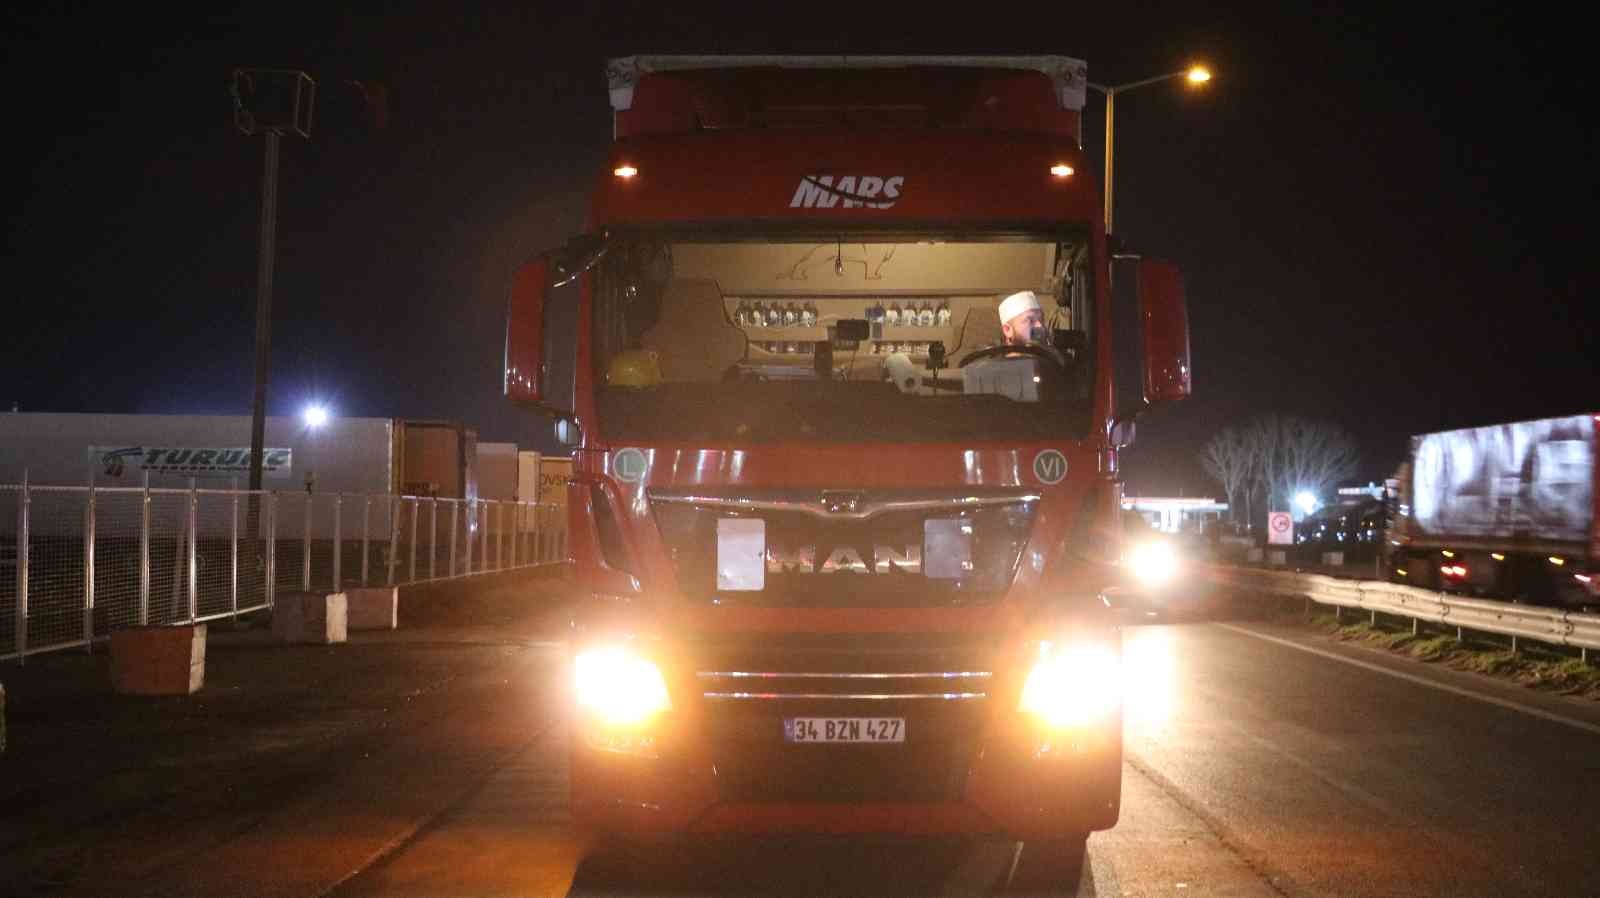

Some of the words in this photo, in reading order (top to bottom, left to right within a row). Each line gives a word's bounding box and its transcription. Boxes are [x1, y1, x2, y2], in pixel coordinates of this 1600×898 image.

[789, 175, 905, 209] MARS
[767, 545, 922, 574] MAN
[796, 720, 818, 740] 34
[825, 720, 860, 740] BZN
[866, 720, 900, 740] 427
